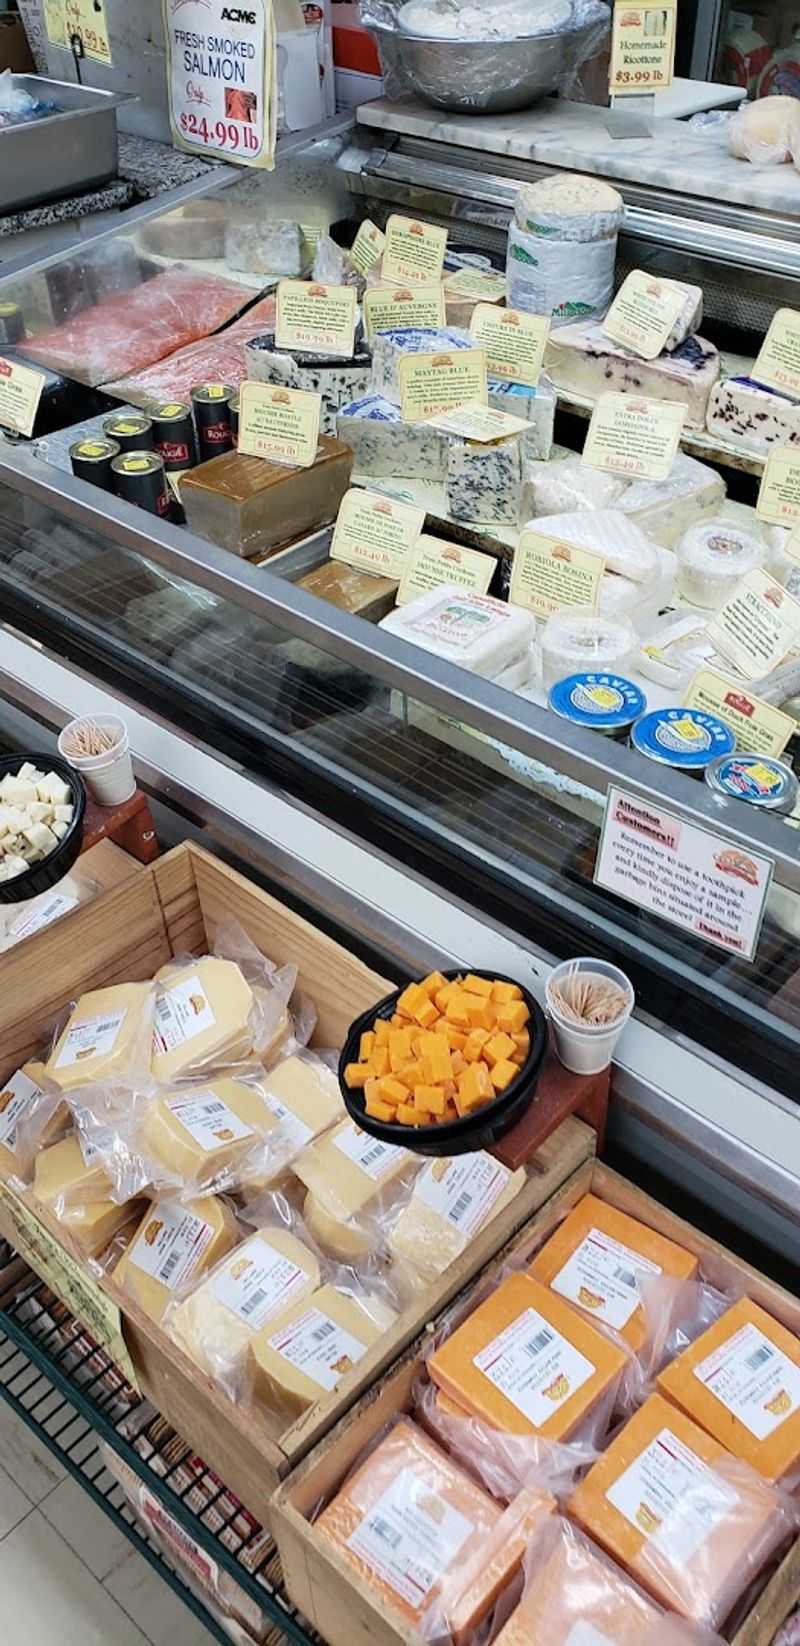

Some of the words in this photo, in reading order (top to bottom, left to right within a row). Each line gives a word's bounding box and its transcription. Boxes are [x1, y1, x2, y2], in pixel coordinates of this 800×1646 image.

[221, 8, 256, 24] ACME
[174, 30, 205, 49] FRESH
[207, 36, 256, 59] SMOKED
[620, 40, 667, 50] Homemade
[184, 50, 246, 84] SALMON
[616, 70, 650, 84] $3.99
[653, 70, 663, 80] lb
[180, 111, 240, 150] $24.99
[244, 127, 259, 151] lb
[414, 369, 447, 377] MAYTAG
[587, 675, 638, 705] CAVIAR
[667, 711, 727, 742] CAVIAR
[617, 799, 661, 826] Attention
[615, 811, 676, 848] Customers!!
[612, 841, 635, 857] every
[636, 850, 656, 867] time
[657, 864, 673, 877] you
[675, 870, 700, 892] enjoy
[620, 831, 665, 859] Remember
[667, 856, 677, 865] to
[677, 862, 692, 873] use
[702, 871, 745, 899] toothpick
[613, 866, 647, 887] garbage
[649, 881, 668, 898] bins
[669, 892, 703, 915] situated
[705, 910, 739, 932] around
[615, 854, 631, 867] and
[632, 862, 660, 882] kindly
[661, 876, 693, 898] dispose
[694, 891, 705, 903] of
[706, 898, 714, 909] it
[715, 904, 725, 915] in
[727, 907, 742, 921] the
[651, 896, 665, 909] the
[698, 921, 723, 939] Thank
[723, 934, 743, 949] you!
